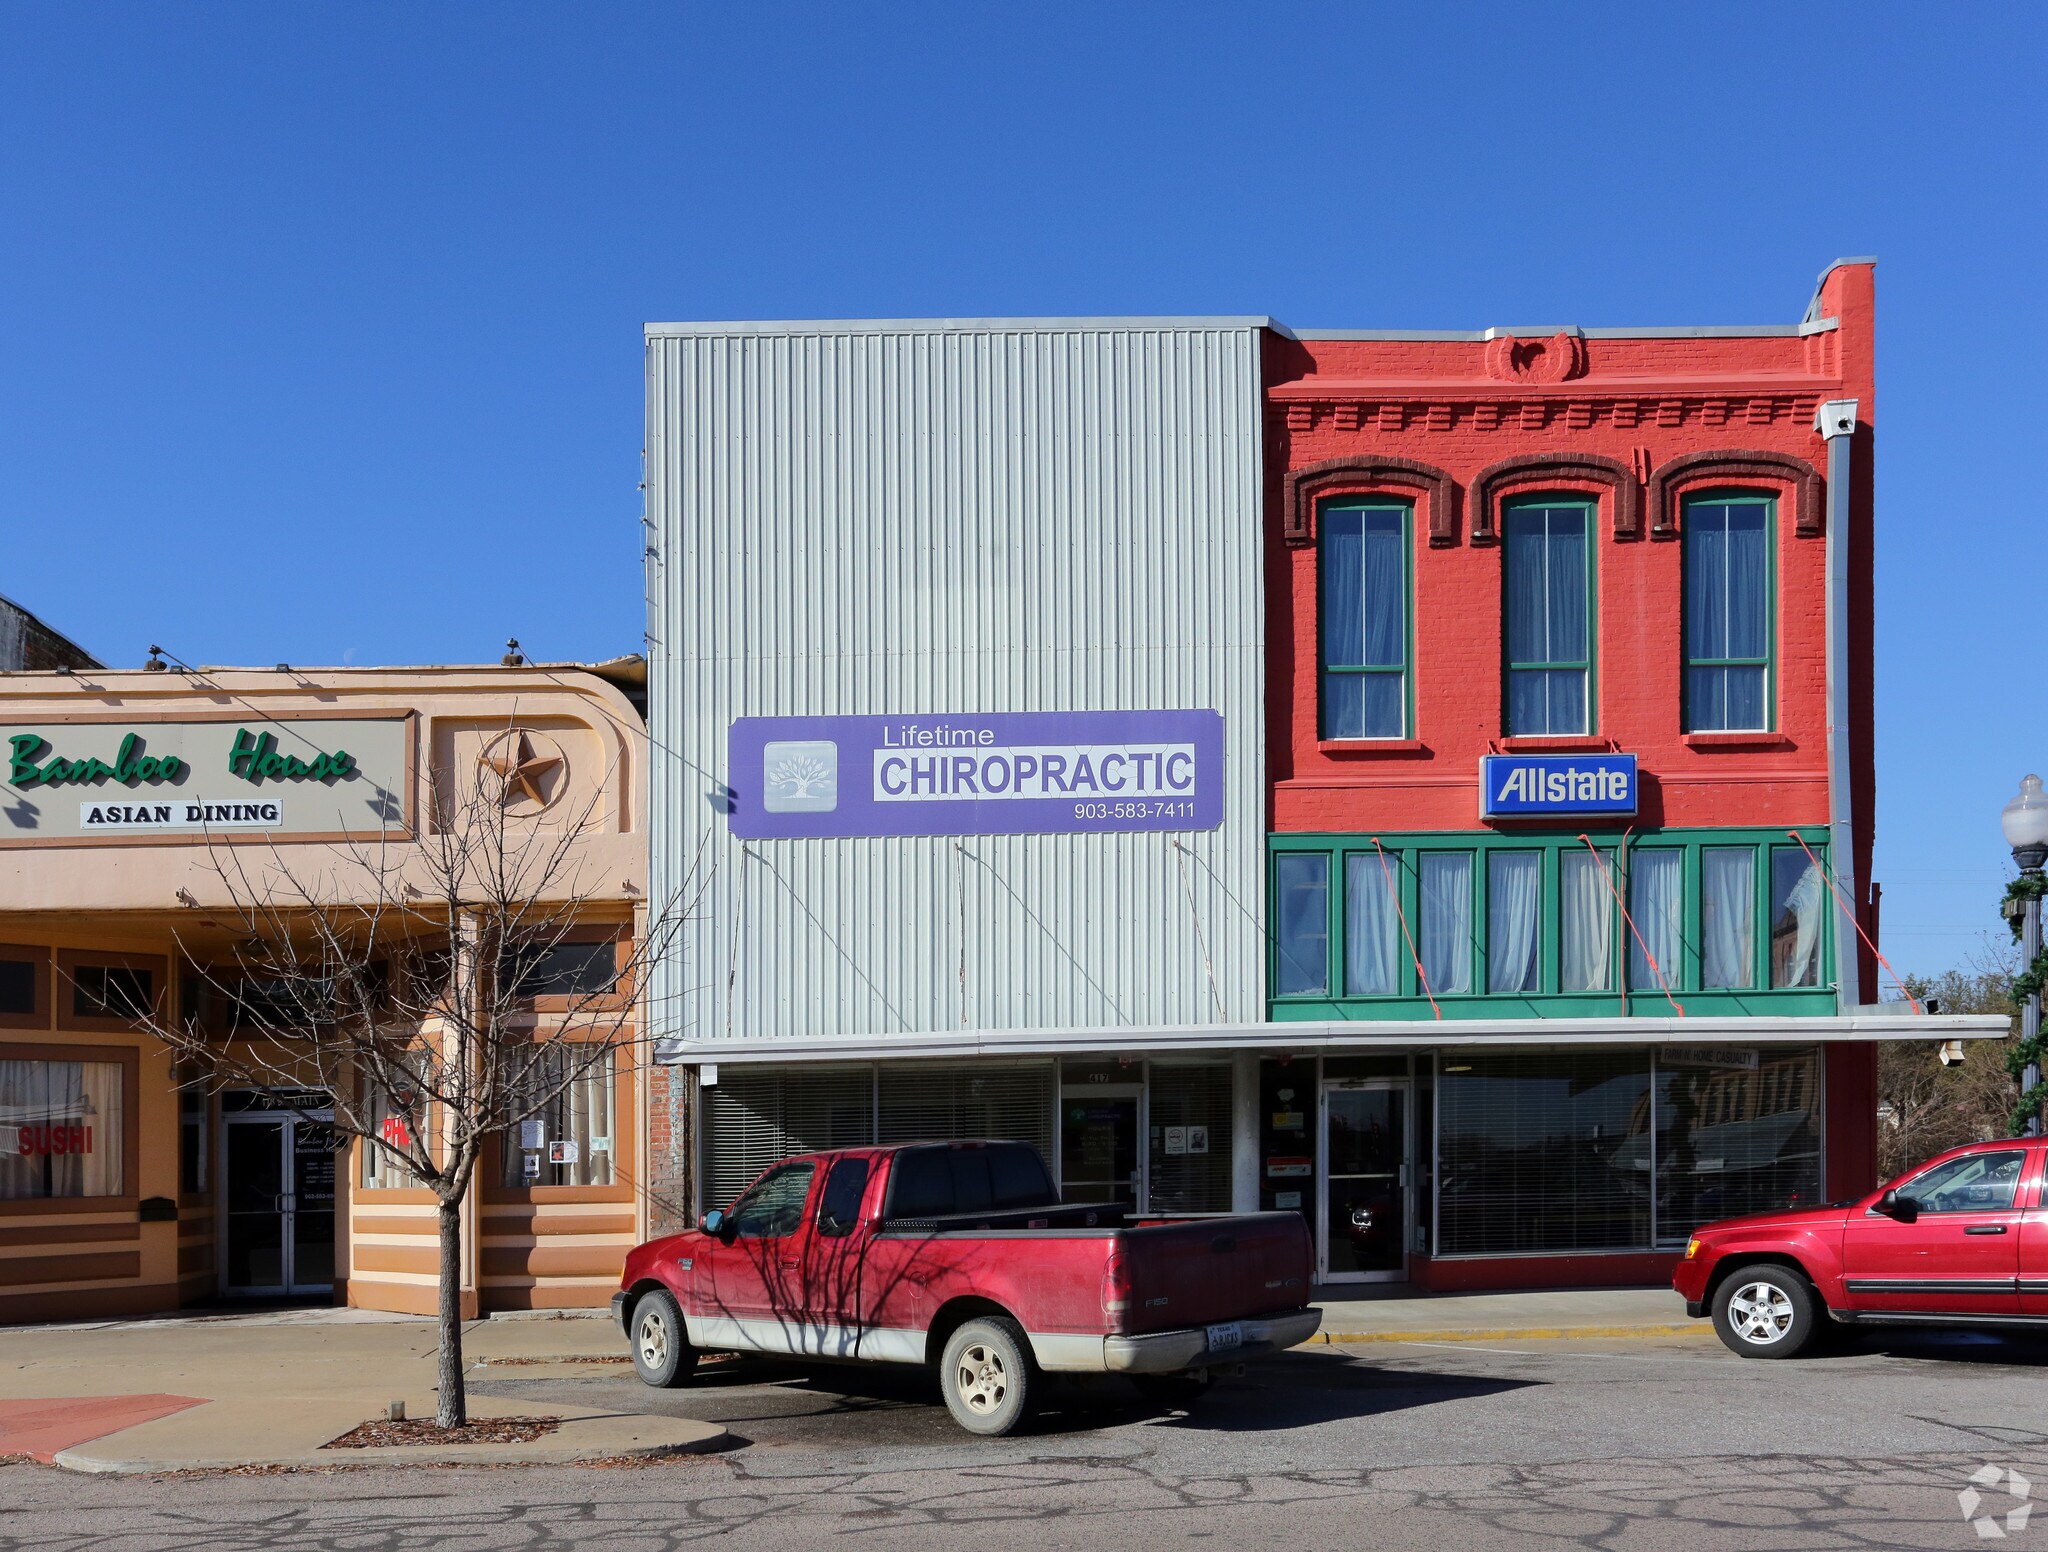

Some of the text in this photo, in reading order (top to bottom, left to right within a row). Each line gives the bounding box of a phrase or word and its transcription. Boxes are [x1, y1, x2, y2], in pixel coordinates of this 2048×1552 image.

[882, 725, 995, 747] Lifetime
[7, 728, 353, 785] Bamboo House
[879, 751, 1194, 796] CHIROPRACTIC
[1497, 767, 1628, 802] Allstate
[87, 804, 279, 823] ASIAN DINING
[1074, 802, 1195, 819] 903-583-7411
[1664, 1048, 1682, 1060] FARM
[1694, 1049, 1713, 1062] HOME
[1716, 1051, 1753, 1064] CASUALTY
[1090, 1073, 1108, 1083] 417
[18, 1126, 93, 1156] SUSHI
